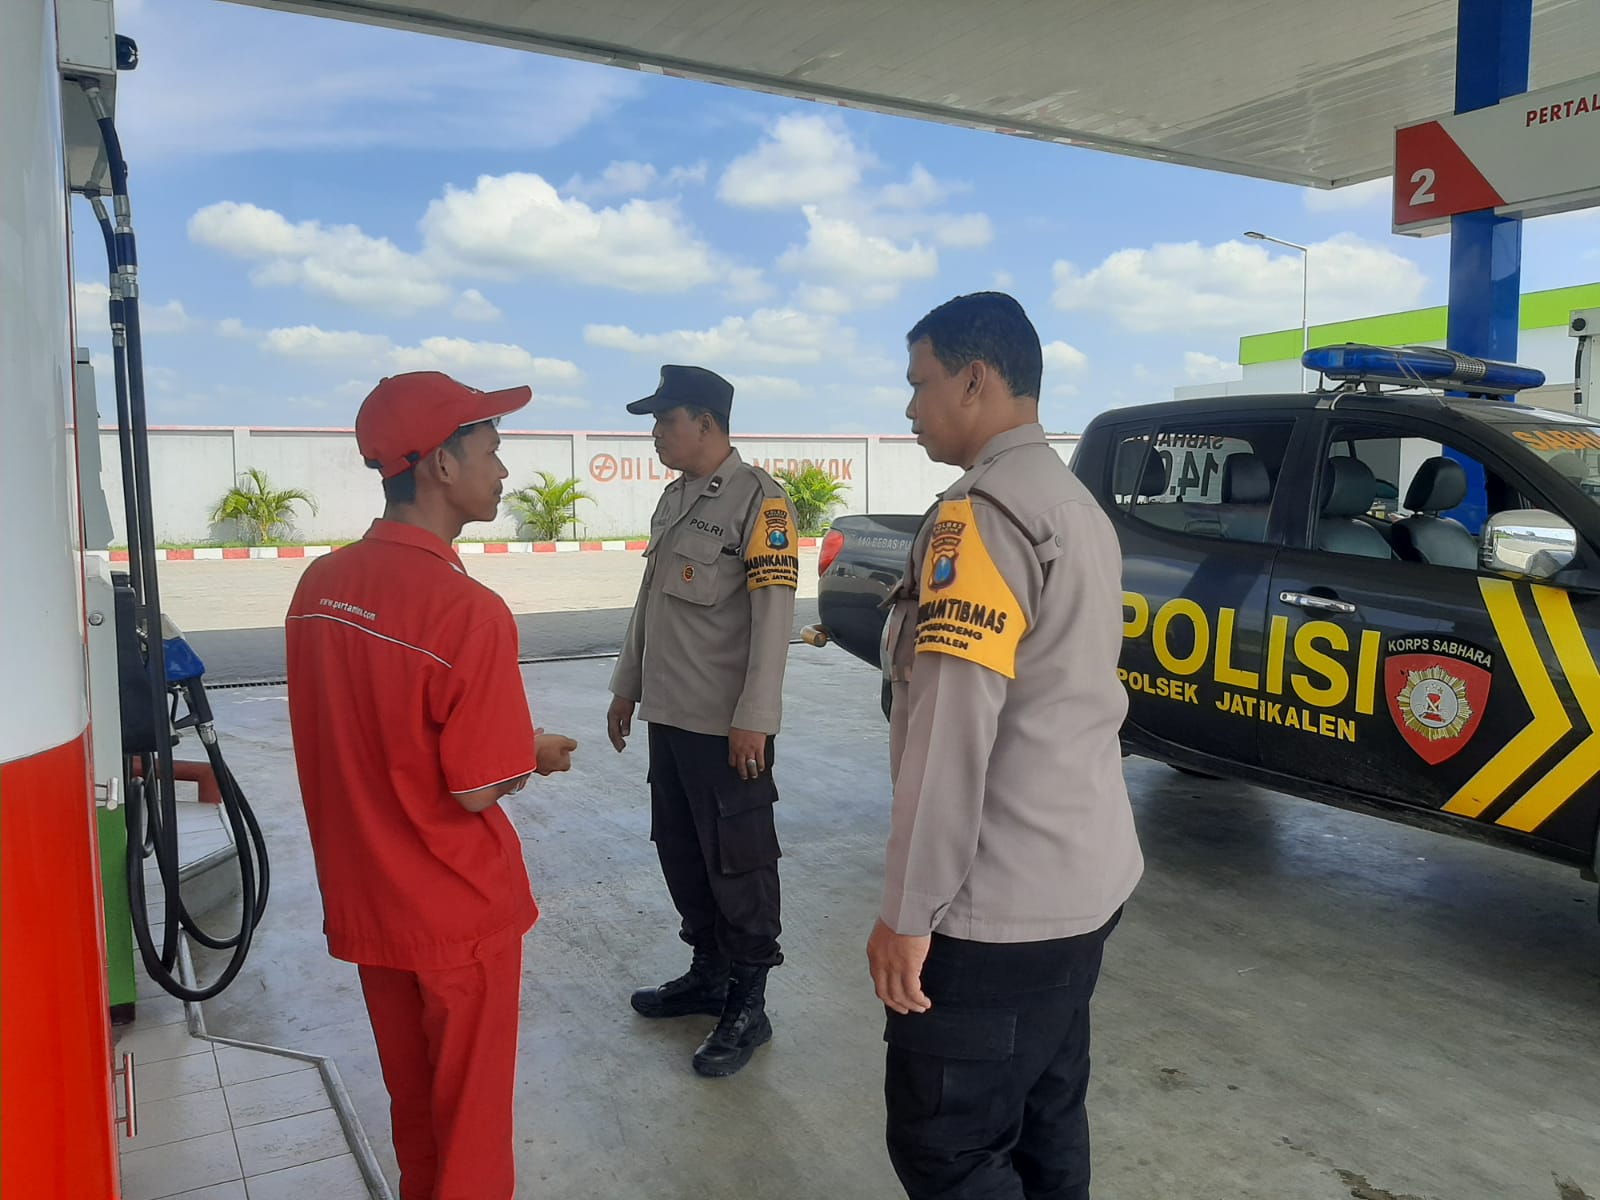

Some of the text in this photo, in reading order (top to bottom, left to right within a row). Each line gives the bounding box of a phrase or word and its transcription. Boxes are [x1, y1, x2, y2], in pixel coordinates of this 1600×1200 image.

[1409, 168, 1436, 206] 2
[690, 518, 724, 536] POLRI
[1121, 590, 1381, 715] POLISI
[1388, 639, 1492, 667] KORPS SABHARA
[1117, 668, 1356, 742] POLSEK JATIKALEN
